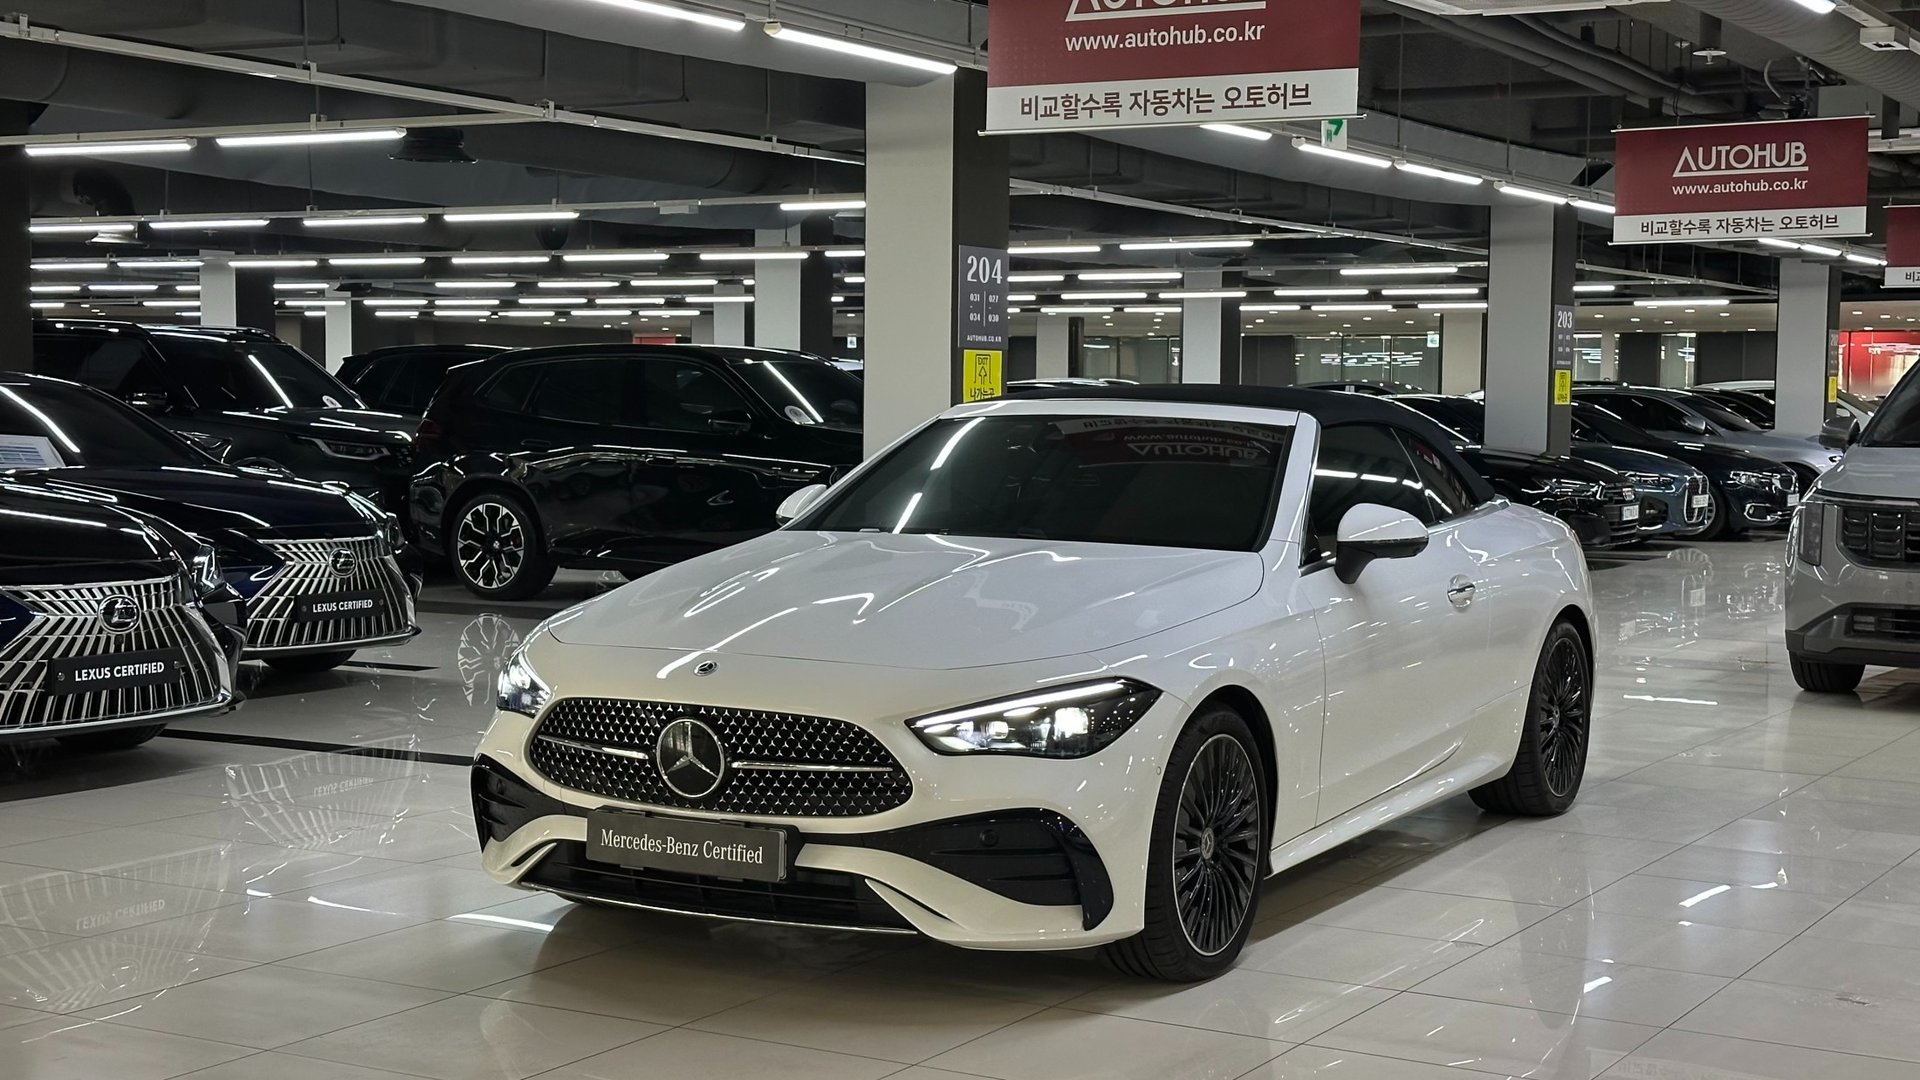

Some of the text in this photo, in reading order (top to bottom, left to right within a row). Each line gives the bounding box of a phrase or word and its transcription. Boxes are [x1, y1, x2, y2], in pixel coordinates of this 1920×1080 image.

[1065, 21, 1265, 51] www.autohub.co.kr
[1020, 83, 1312, 121] 비교할수록 자동차는 오토허브
[1672, 141, 1809, 177] AUTOHUB
[1672, 178, 1808, 195] www.autohub.co.kr
[1641, 213, 1839, 236] 비교할수록 자동차는 오토허브
[966, 255, 1003, 284] 204
[1557, 310, 1573, 328] 203
[312, 599, 373, 613] LEXUS CERTIFIED
[75, 662, 164, 682] LEXUS CERTIFIED
[600, 828, 763, 864] Mercedes-Benz Certified
